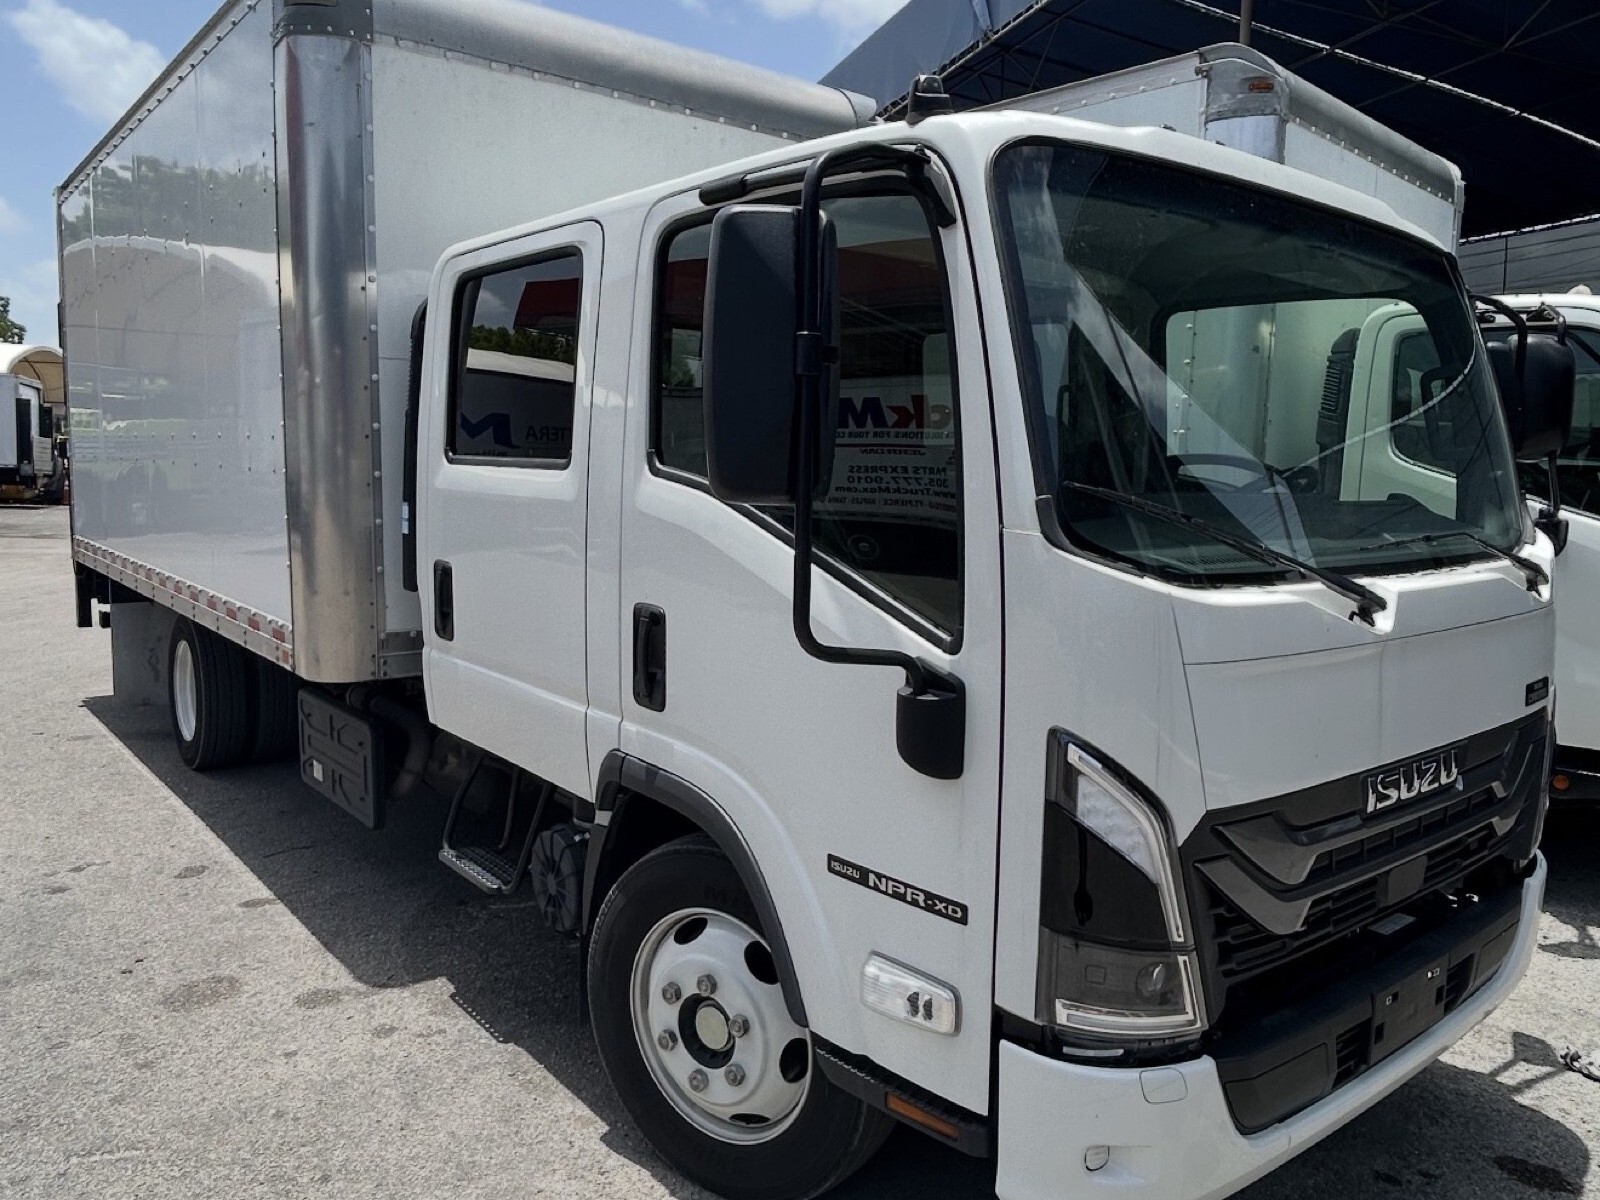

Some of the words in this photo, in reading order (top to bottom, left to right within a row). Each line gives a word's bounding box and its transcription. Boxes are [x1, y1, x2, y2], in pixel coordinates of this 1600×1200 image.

[1366, 750, 1458, 814] ISUZU
[830, 860, 860, 879] ISUZU
[868, 872, 963, 919] NPR-XD
